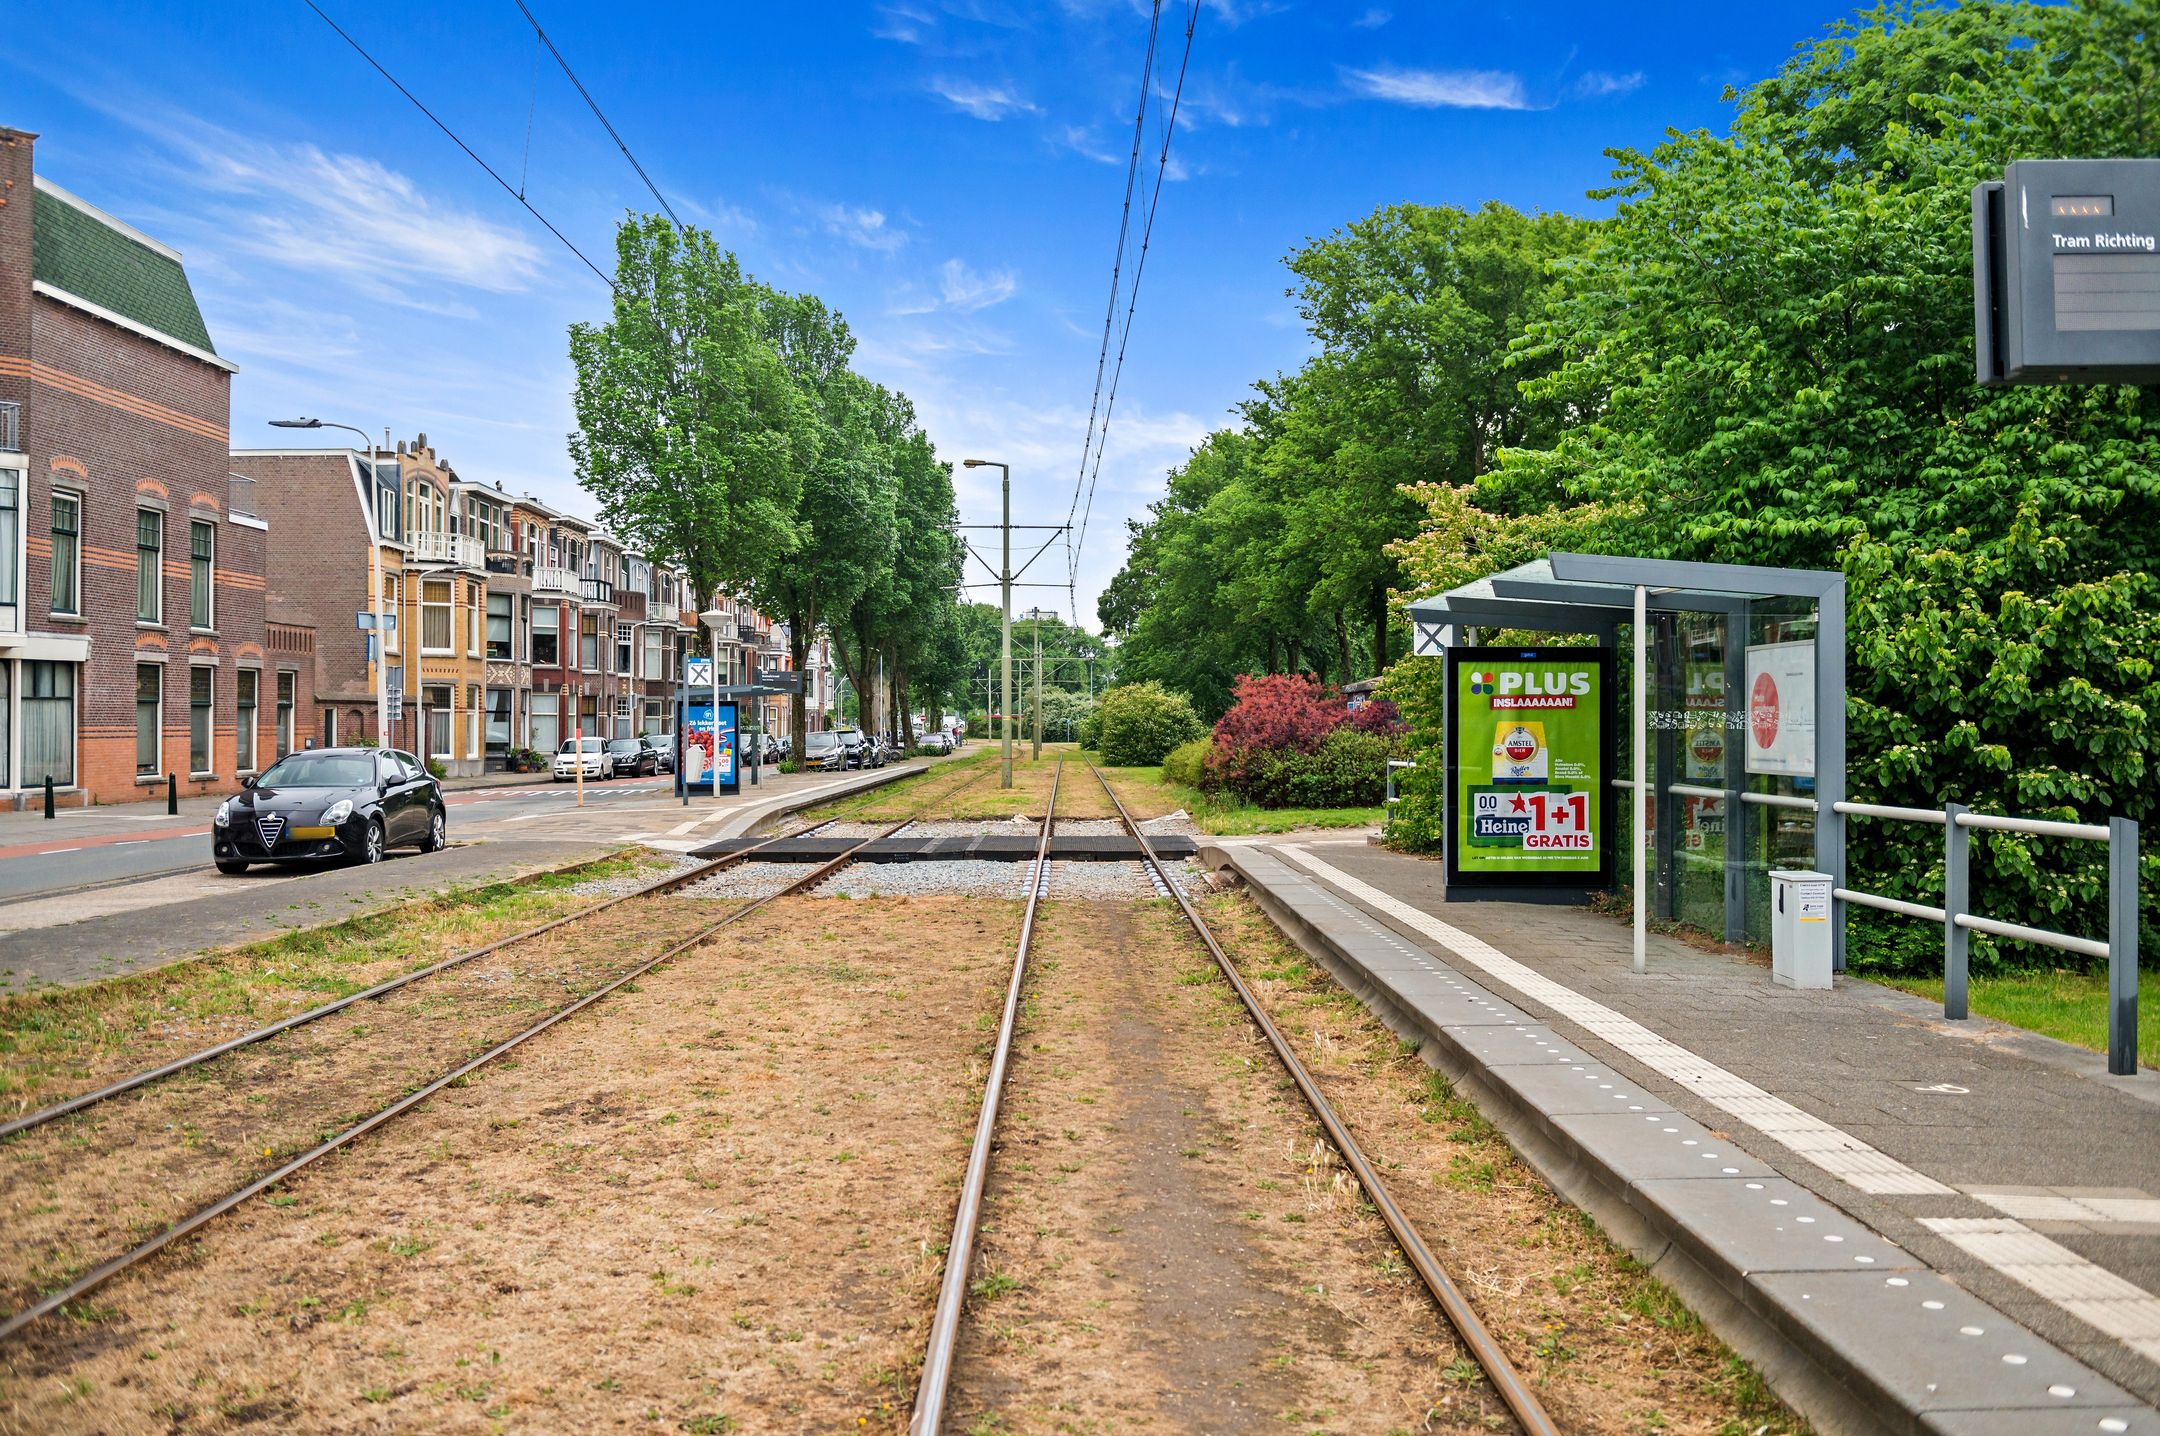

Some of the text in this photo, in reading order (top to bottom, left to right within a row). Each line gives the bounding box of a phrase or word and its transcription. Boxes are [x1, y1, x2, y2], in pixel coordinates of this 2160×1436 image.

[2052, 233, 2156, 251] Tram Richting
[1500, 672, 1590, 695] PLUS
[1479, 796, 1497, 809] 0.0
[1528, 795, 1586, 832] 1+1
[1481, 819, 1531, 834] Heine
[1526, 834, 1590, 848] GRATIS
